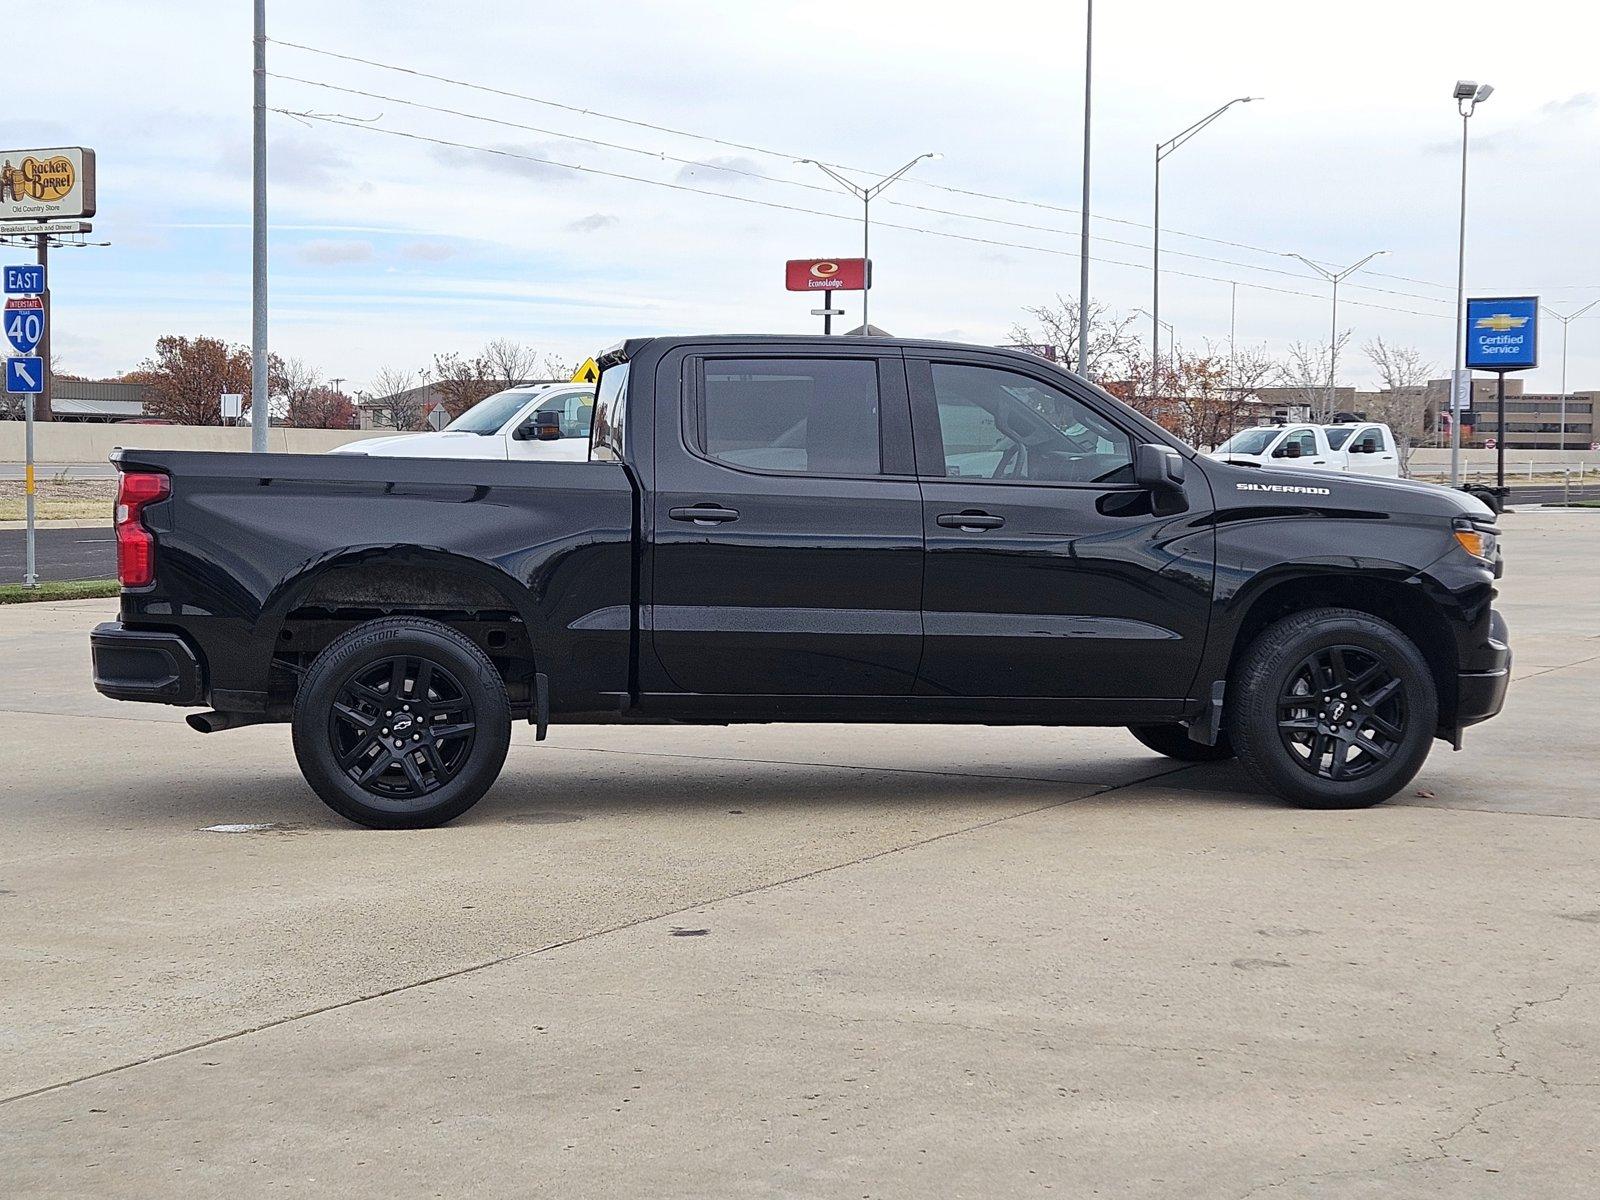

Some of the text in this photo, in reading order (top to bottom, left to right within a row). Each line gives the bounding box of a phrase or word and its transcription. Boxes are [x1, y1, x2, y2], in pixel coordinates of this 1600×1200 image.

[21, 159, 68, 182] Cracker
[32, 174, 70, 198] Barrel
[8, 270, 38, 289] EAST
[808, 278, 843, 288] EconoLodge
[9, 300, 39, 308] INTERSTATE
[8, 315, 40, 343] 40
[1479, 335, 1524, 345] Certified
[1482, 345, 1520, 354] Service
[1235, 483, 1330, 495] SILVERADO
[330, 629, 400, 667] BRIDGESTONE
